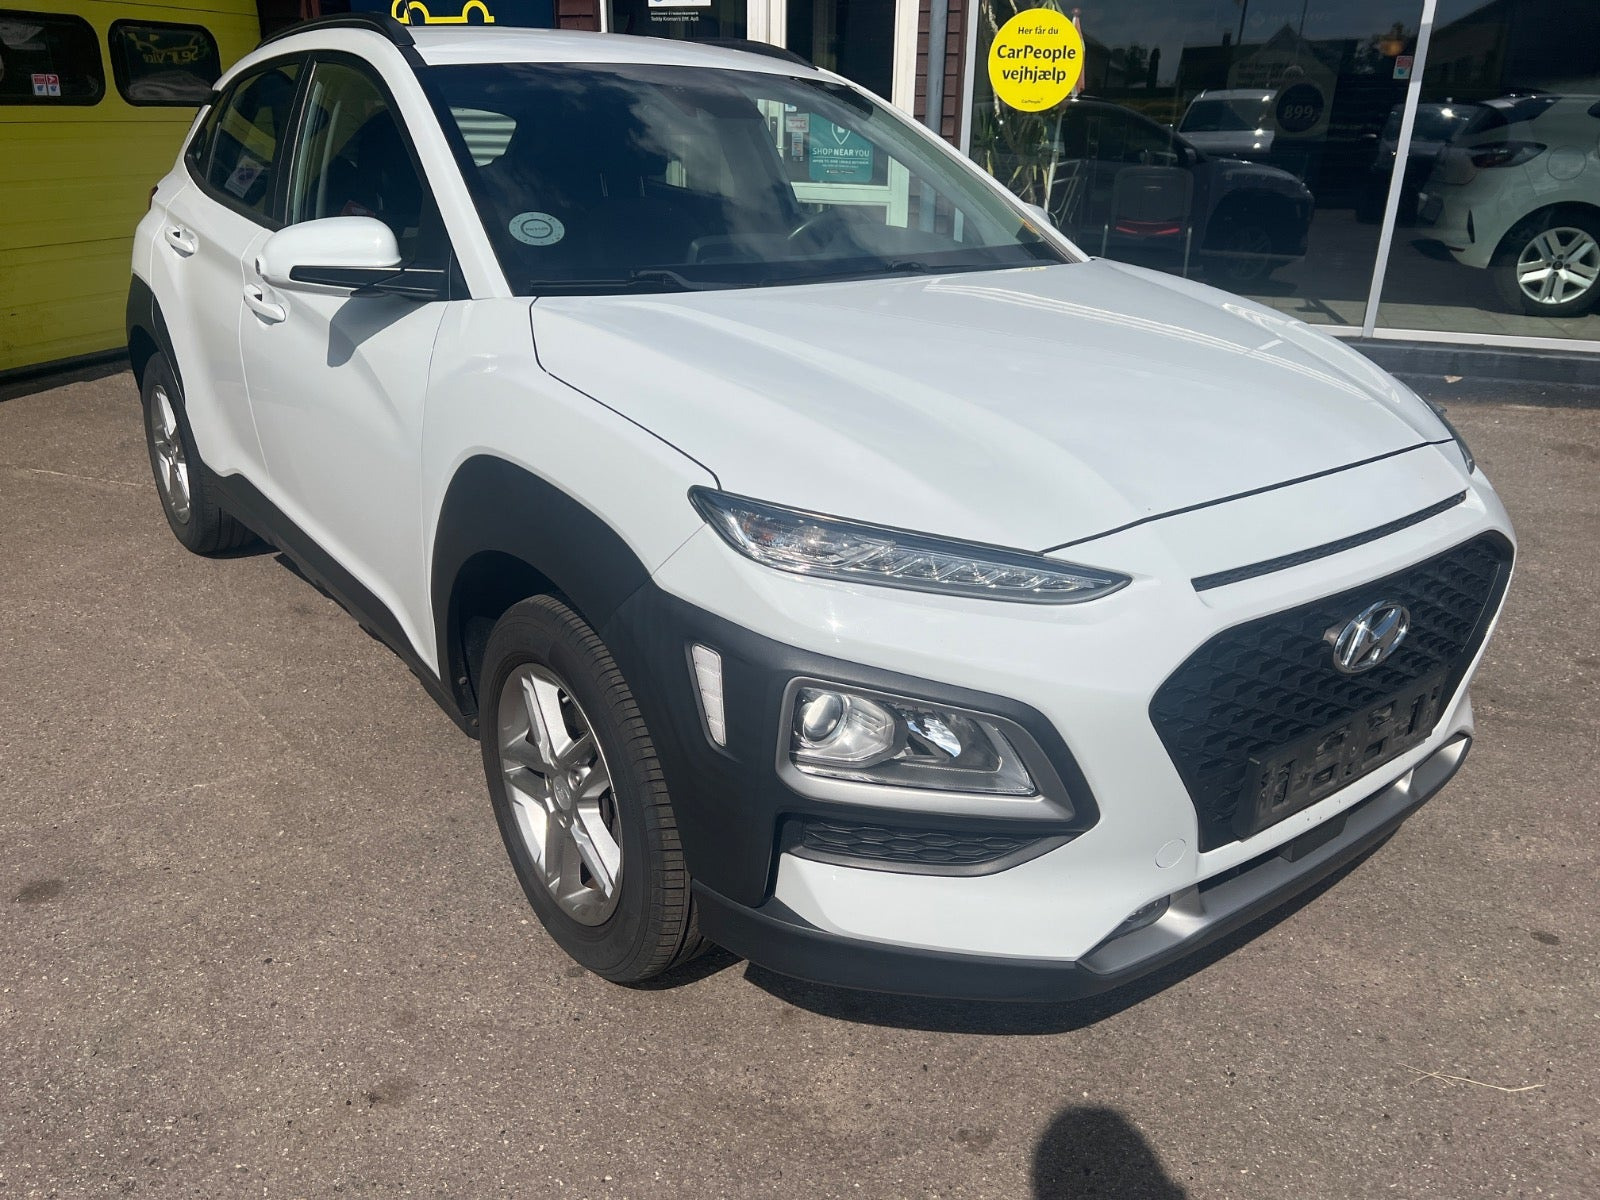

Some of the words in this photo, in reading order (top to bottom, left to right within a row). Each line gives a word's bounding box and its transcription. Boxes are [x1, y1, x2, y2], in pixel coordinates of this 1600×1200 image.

[1035, 25, 1046, 34] får
[997, 45, 1076, 62] CarPeople
[1002, 66, 1066, 84] vejhjælp
[833, 148, 854, 156] NEAR
